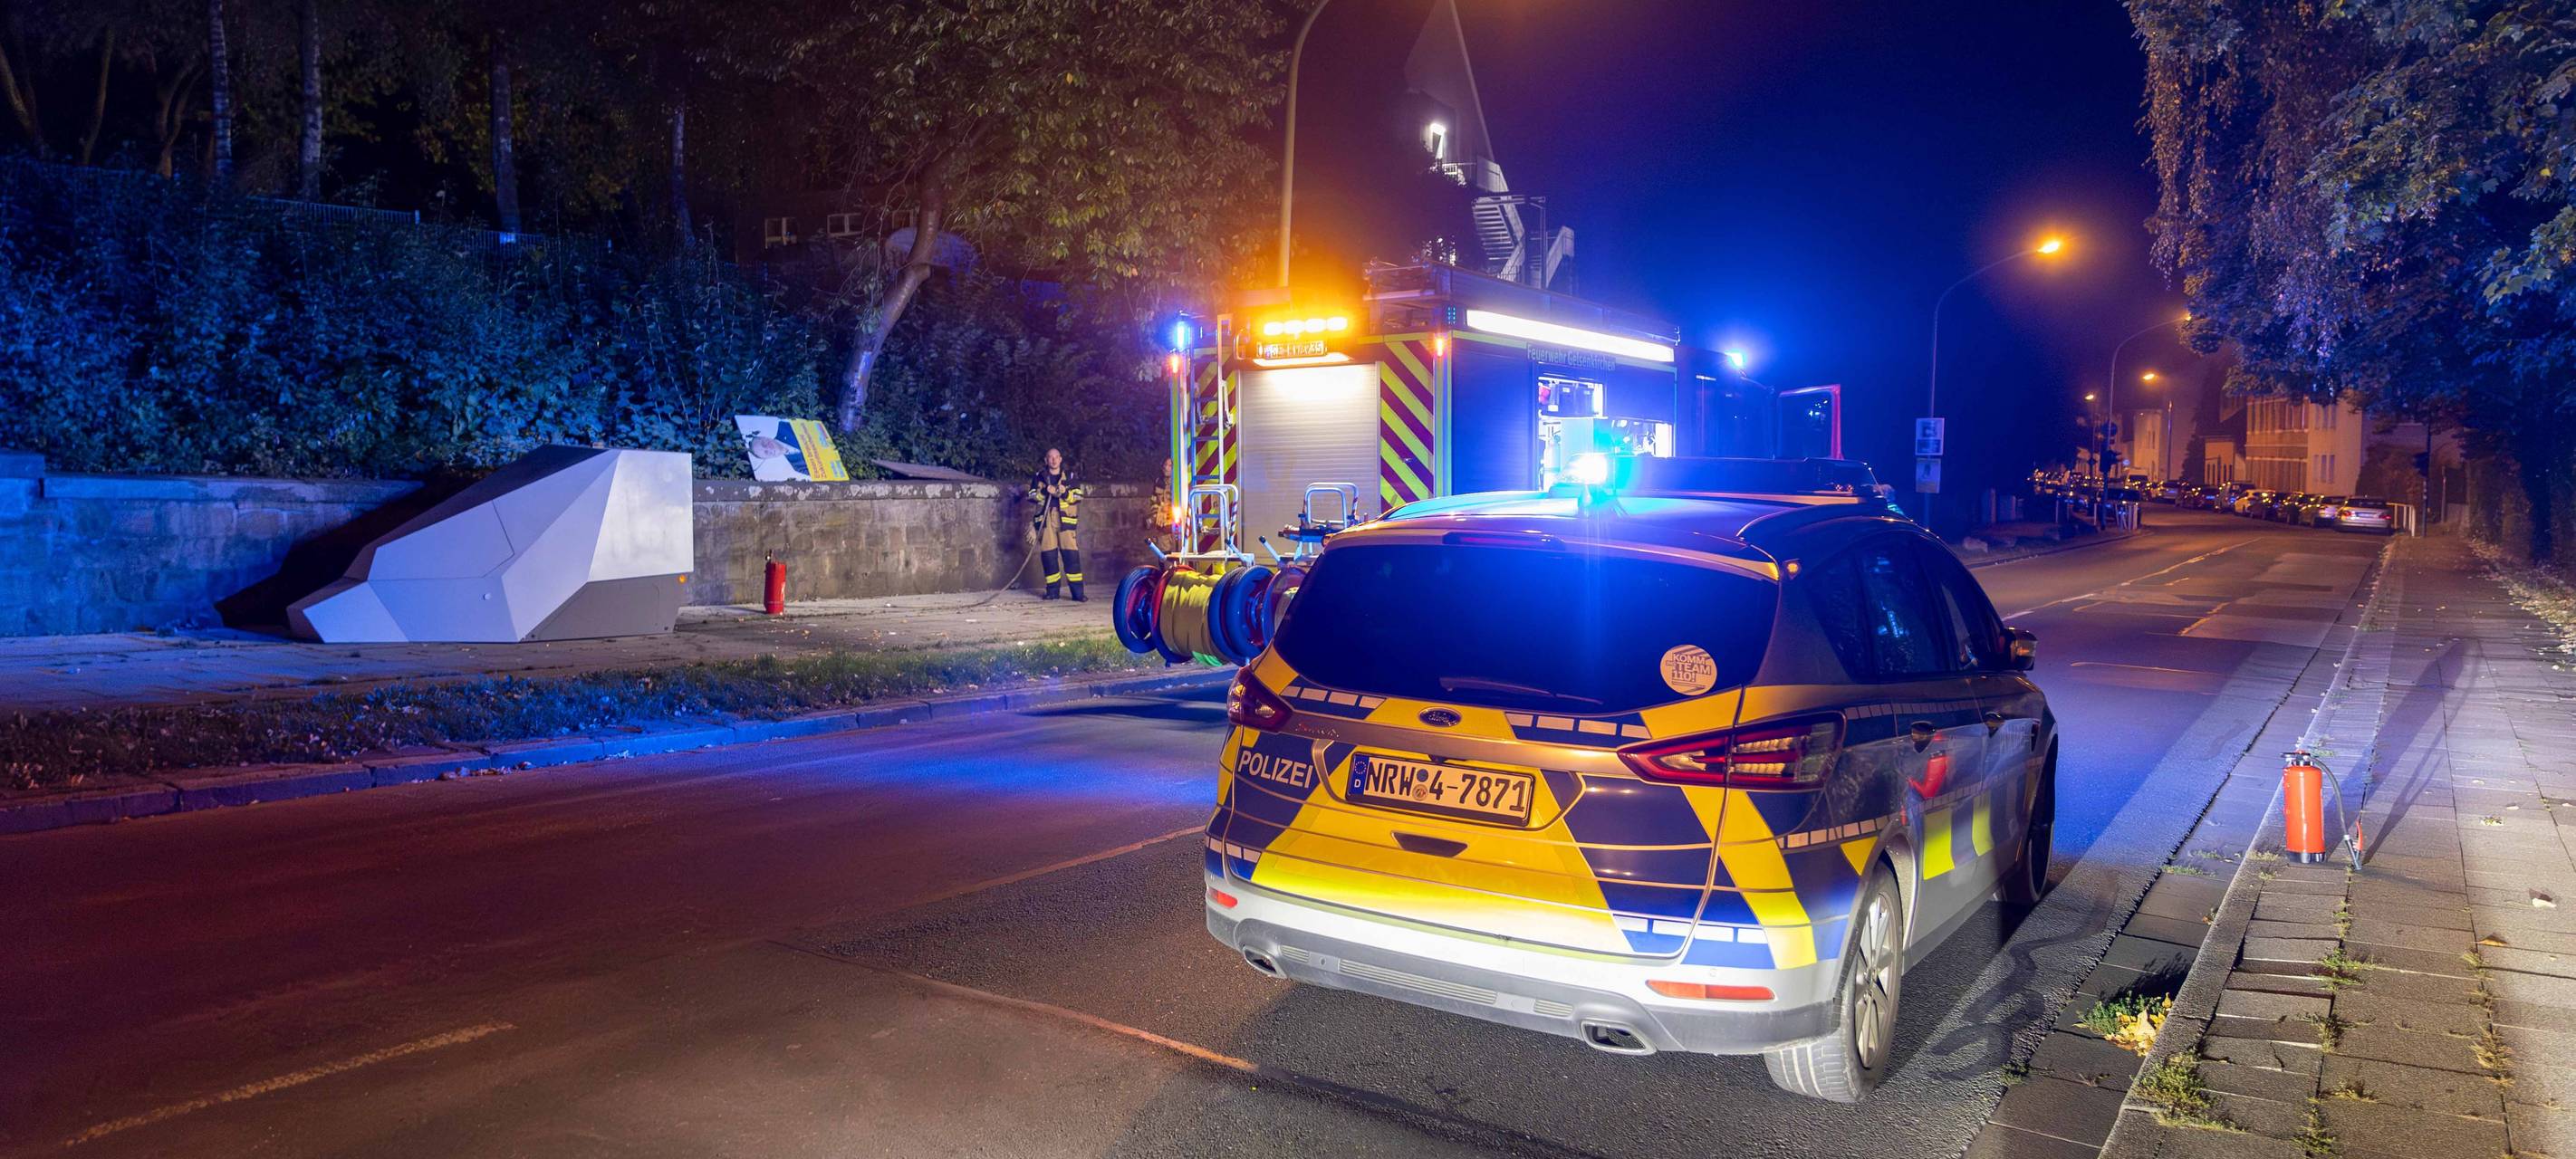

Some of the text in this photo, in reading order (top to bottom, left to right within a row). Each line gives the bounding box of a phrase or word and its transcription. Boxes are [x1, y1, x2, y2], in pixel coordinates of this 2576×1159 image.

[1528, 344, 1616, 371] Feuerwehr Gelsenkirchen
[1674, 654, 1705, 665] KOMM
[1678, 663, 1710, 675] TEAM
[1673, 671, 1696, 682] 110!
[1238, 750, 1313, 789] POLIZEI
[1354, 779, 1361, 788] D
[1365, 761, 1526, 812] NRW 4-7871
